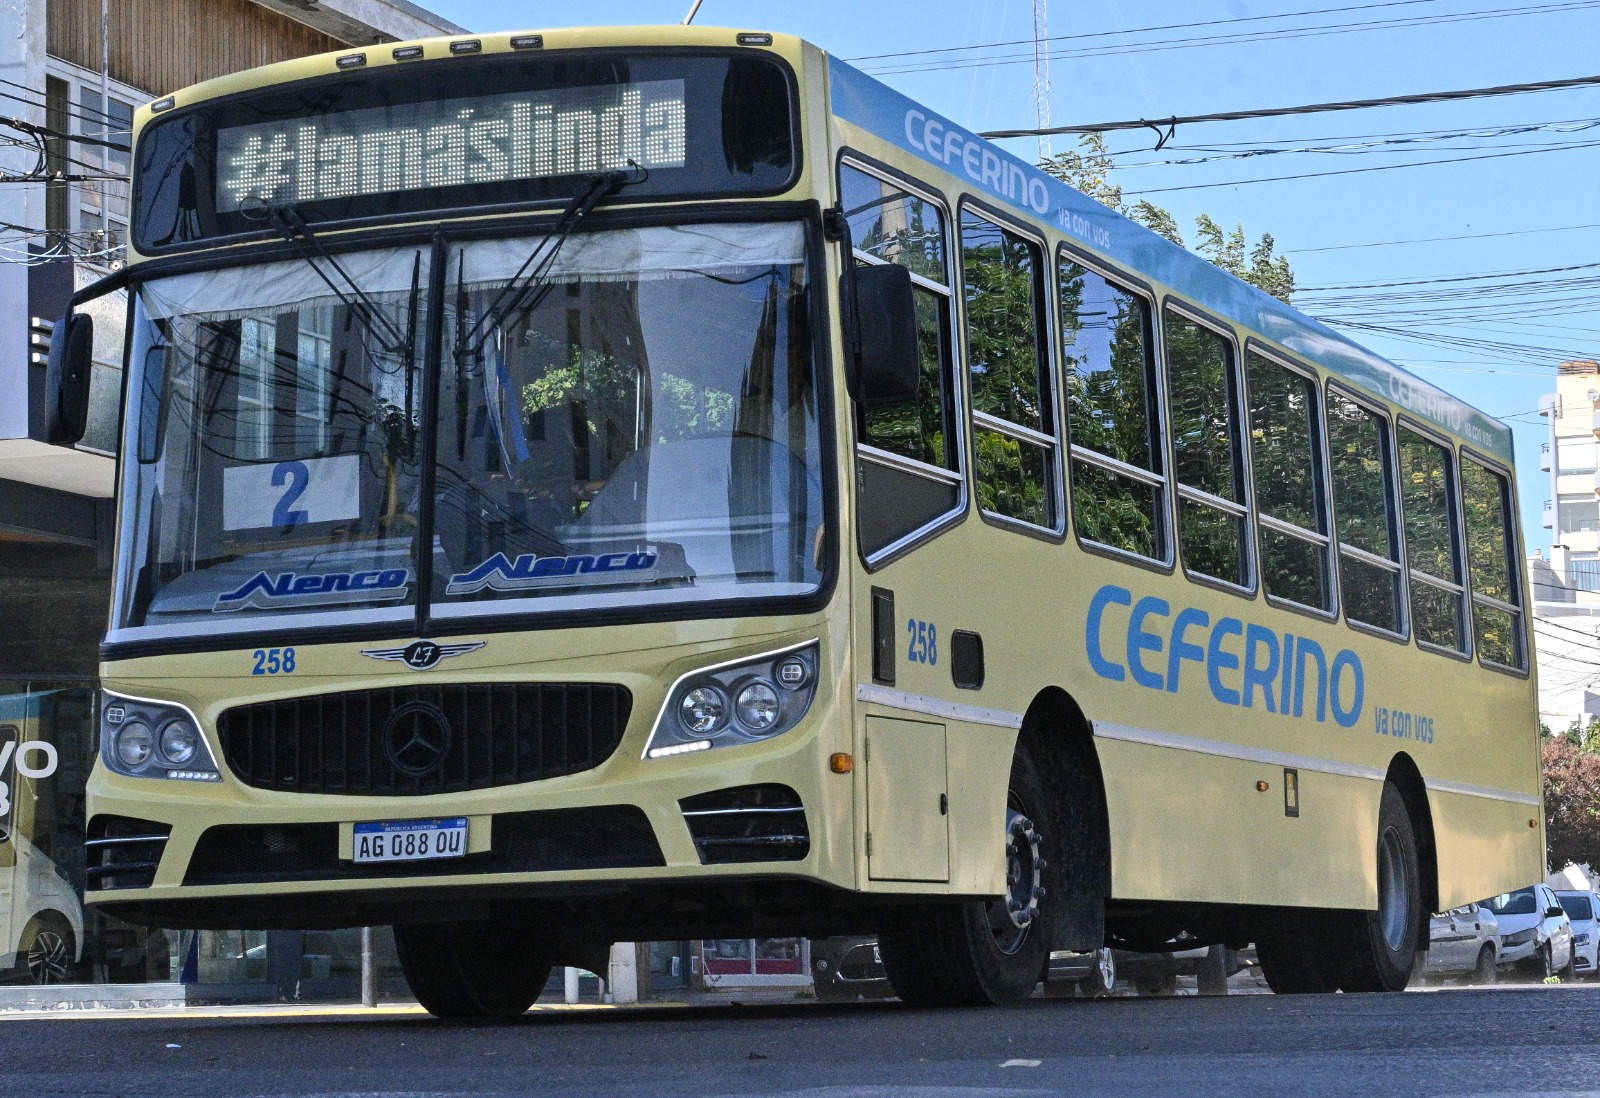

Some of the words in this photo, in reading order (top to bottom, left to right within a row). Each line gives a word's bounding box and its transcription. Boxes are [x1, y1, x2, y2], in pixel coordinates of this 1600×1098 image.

[904, 109, 1049, 215] CEFERINO
[1058, 207, 1070, 229] va
[1072, 214, 1091, 239] con
[1093, 224, 1110, 249] vos
[1388, 372, 1461, 432] CEFERINO
[270, 460, 309, 527] 2
[216, 568, 409, 605] Alenco
[447, 551, 660, 587] Alenco
[252, 648, 296, 675] 258
[908, 618, 937, 666] 258
[1085, 584, 1365, 728] CEFERINO
[1375, 706, 1389, 735] va
[1391, 709, 1411, 739] con
[1414, 715, 1434, 745] vos
[360, 835, 384, 858] AG
[391, 832, 429, 857] 088
[435, 830, 460, 853] OU
